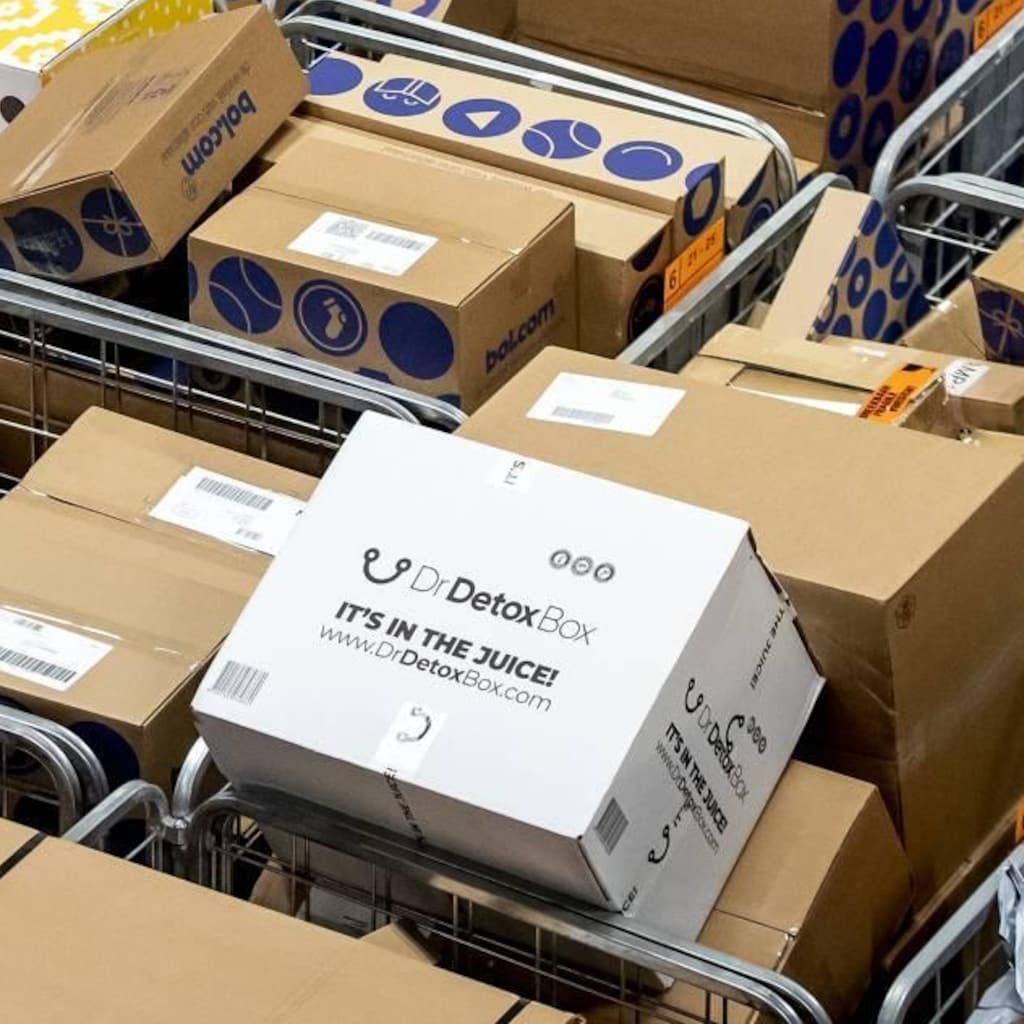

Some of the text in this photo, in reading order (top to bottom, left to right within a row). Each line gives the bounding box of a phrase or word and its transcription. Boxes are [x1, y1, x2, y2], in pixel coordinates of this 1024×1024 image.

[181, 90, 256, 175] bol.com
[669, 270, 676, 290] 6
[688, 249, 697, 266] 21
[705, 236, 716, 251] 25
[485, 298, 554, 374] bol.com
[504, 459, 526, 485] IT'S
[320, 624, 553, 712] www.DrDetoxBox.com
[335, 601, 560, 688] IT'S IN THE JUICE!
[679, 747, 691, 770] IN
[689, 762, 706, 794] THE
